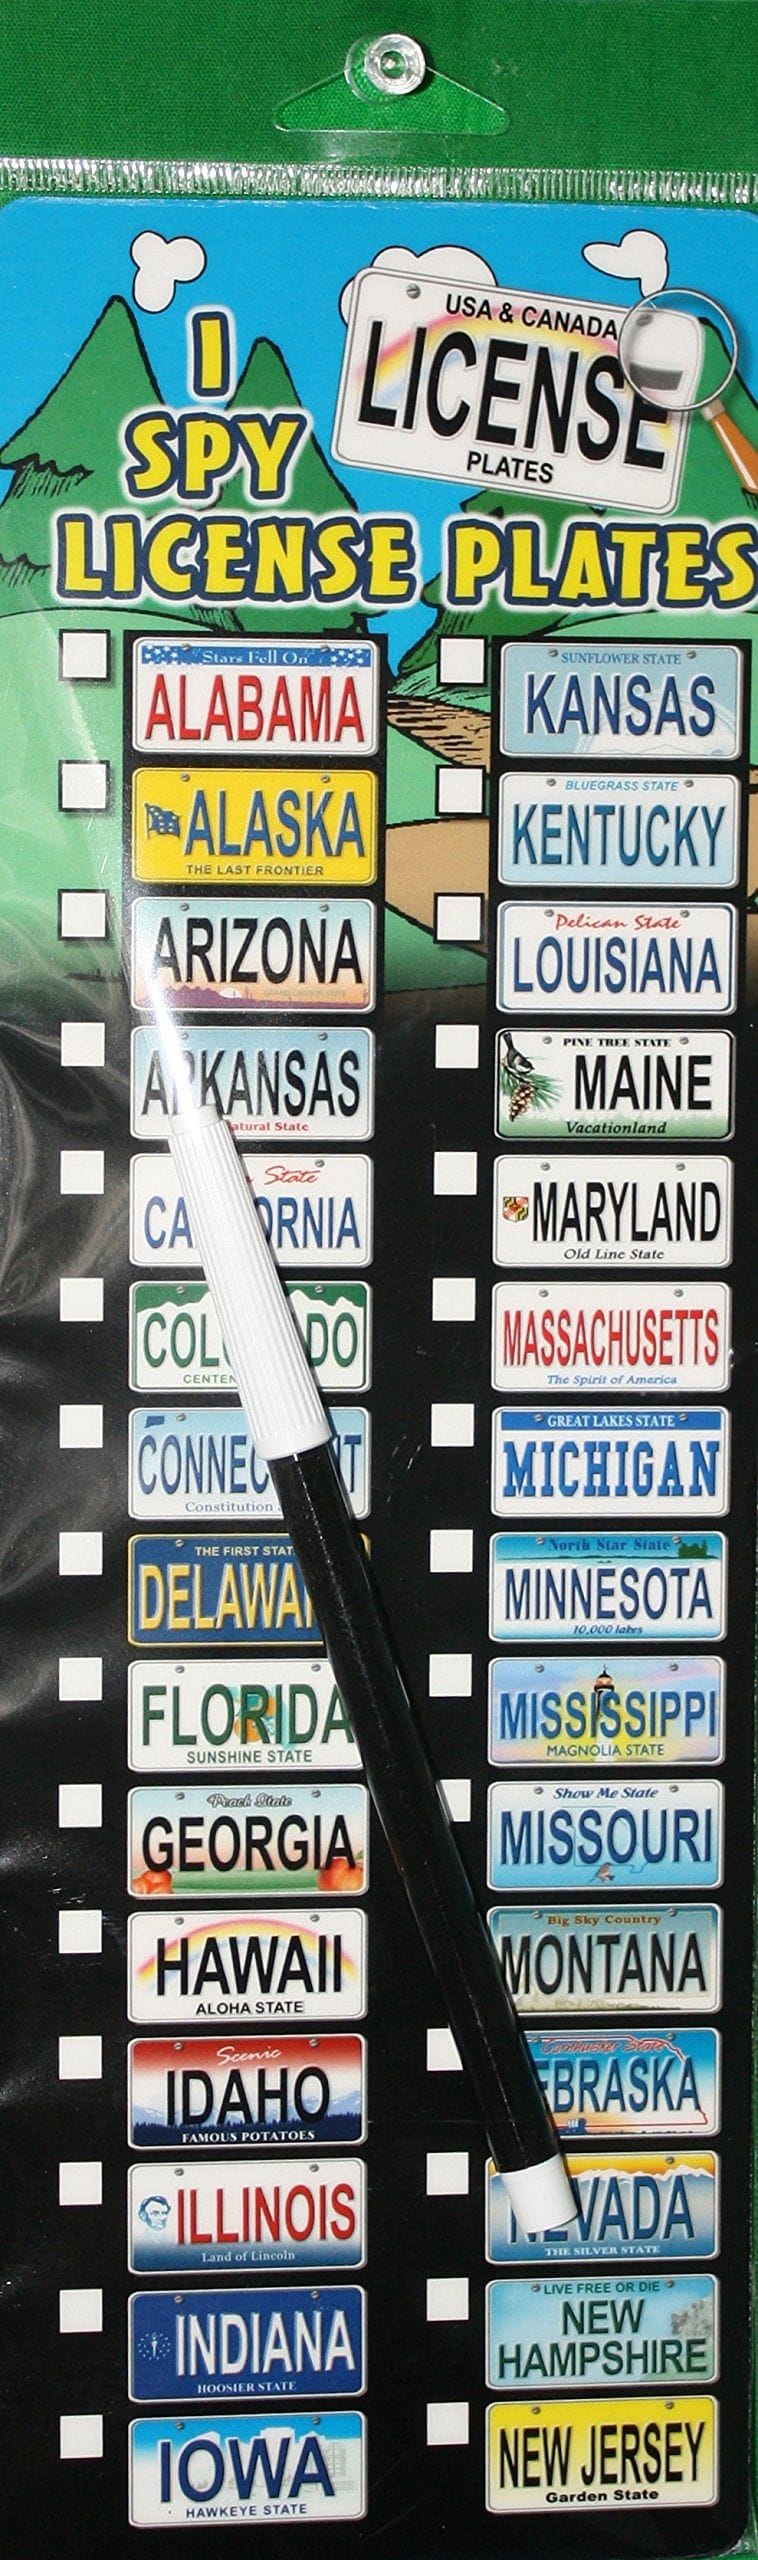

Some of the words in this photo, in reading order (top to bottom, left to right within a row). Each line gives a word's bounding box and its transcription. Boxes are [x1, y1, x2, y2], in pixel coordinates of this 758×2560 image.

[445, 293, 492, 321] USA
[499, 303, 515, 324] &
[522, 305, 618, 341] CANADA
[192, 311, 230, 398] I
[357, 320, 668, 470] LICENSE
[126, 413, 309, 502] SPY
[466, 451, 553, 484] PLATES
[56, 512, 416, 603] LICENSE
[447, 517, 758, 610] PLATES
[202, 651, 243, 664] Stars
[282, 653, 308, 664] On
[561, 652, 640, 665] SUNFLOWER
[642, 654, 682, 665] STATE
[144, 673, 365, 742] ALABAMA
[527, 673, 716, 737] KANSAS
[565, 780, 639, 791] BLUEGRASS
[642, 781, 679, 792] STATE
[184, 789, 366, 858] ALASKA
[513, 804, 726, 867] KENTUCKY
[186, 865, 212, 875] THE
[217, 865, 251, 875] LAST
[256, 865, 324, 876] FRONTIER
[555, 914, 627, 931] Pelican
[634, 915, 681, 931] State
[152, 917, 363, 984] ARIZONA
[513, 936, 722, 993] LOUISIANA
[563, 1038, 593, 1047] PINE
[597, 1038, 631, 1047] TREE
[634, 1039, 672, 1047] STATE
[574, 1054, 712, 1111] MAINE
[228, 1121, 270, 1132] atural
[274, 1122, 309, 1132] State
[566, 1121, 667, 1134] Vacationland
[264, 1165, 321, 1186] State
[532, 1181, 721, 1242] MARYLAND
[564, 1248, 590, 1260] Old
[596, 1249, 626, 1260] Line
[629, 1249, 665, 1260] State
[143, 1312, 358, 1368] COLDO
[504, 1309, 719, 1367] MASSACHUSETTS
[547, 1375, 569, 1385] The
[573, 1375, 608, 1386] Spirit
[611, 1375, 623, 1385] of
[626, 1375, 677, 1385] America
[547, 1414, 588, 1427] GREAT
[593, 1414, 632, 1427] LAKES
[636, 1414, 675, 1427] STATE
[138, 1434, 362, 1495] CONNECT
[503, 1440, 720, 1497] MICHIGAN
[185, 1502, 273, 1512] Constitution
[195, 1547, 220, 1557] THE
[223, 1546, 259, 1557] FIRST
[263, 1546, 295, 1556] STAT
[550, 1539, 590, 1551] North
[596, 1539, 627, 1551] Star
[634, 1538, 671, 1551] State
[139, 1562, 316, 1630] DELAWA
[505, 1567, 713, 1620] MINNESOTA
[573, 1625, 612, 1636] 10,000
[142, 1683, 355, 1746] FLORIDA
[500, 1691, 716, 1740] MISSISSIPPI
[187, 1750, 262, 1763] SUNSHINE
[267, 1750, 313, 1762] STATE
[546, 1745, 621, 1756] MAGNOLIA
[626, 1744, 665, 1756] STATE
[254, 1793, 292, 1807] State
[553, 1787, 594, 1799] Show
[597, 1788, 618, 1799] Me
[621, 1787, 659, 1798] State
[142, 1814, 356, 1872] GEORGIA
[501, 1808, 712, 1865] MISSOURI
[547, 1916, 570, 1926] Big
[574, 1915, 600, 1925] Sky
[604, 1915, 661, 1925] Country
[156, 1935, 342, 1996] HAWAII
[501, 1933, 707, 1995] MONTANA
[196, 2002, 251, 2015] ALOHA
[255, 2000, 304, 2014] STATE
[216, 2046, 282, 2065] Scenic
[167, 2066, 331, 2128] IDAHO
[182, 2132, 237, 2143] FAMOUS
[241, 2130, 315, 2141] POTATOES
[177, 2183, 356, 2244] ILLINOIS
[202, 2252, 231, 2262] Land
[235, 2251, 248, 2261] of
[251, 2250, 295, 2261] Lincoln
[545, 2248, 571, 2256] THE
[573, 2247, 618, 2256] SILVER
[620, 2245, 661, 2255] STATE
[544, 2284, 572, 2294] LIVE
[577, 2283, 611, 2294] FREE
[616, 2283, 635, 2292] OR
[639, 2282, 660, 2291] DIE
[562, 2299, 645, 2336] NEW
[176, 2309, 355, 2377] INDIANA
[499, 2338, 707, 2379] HAMPSHIRE
[198, 2383, 254, 2394] HOOSIER
[258, 2382, 296, 2391] STATE
[160, 2436, 335, 2503] IOWA
[500, 2426, 572, 2488] NEW
[581, 2422, 705, 2486] JERSEY
[186, 2506, 257, 2518] HAWKEYE
[263, 2504, 307, 2515] STATE
[545, 2491, 607, 2503] Garden
[613, 2489, 659, 2500] State
